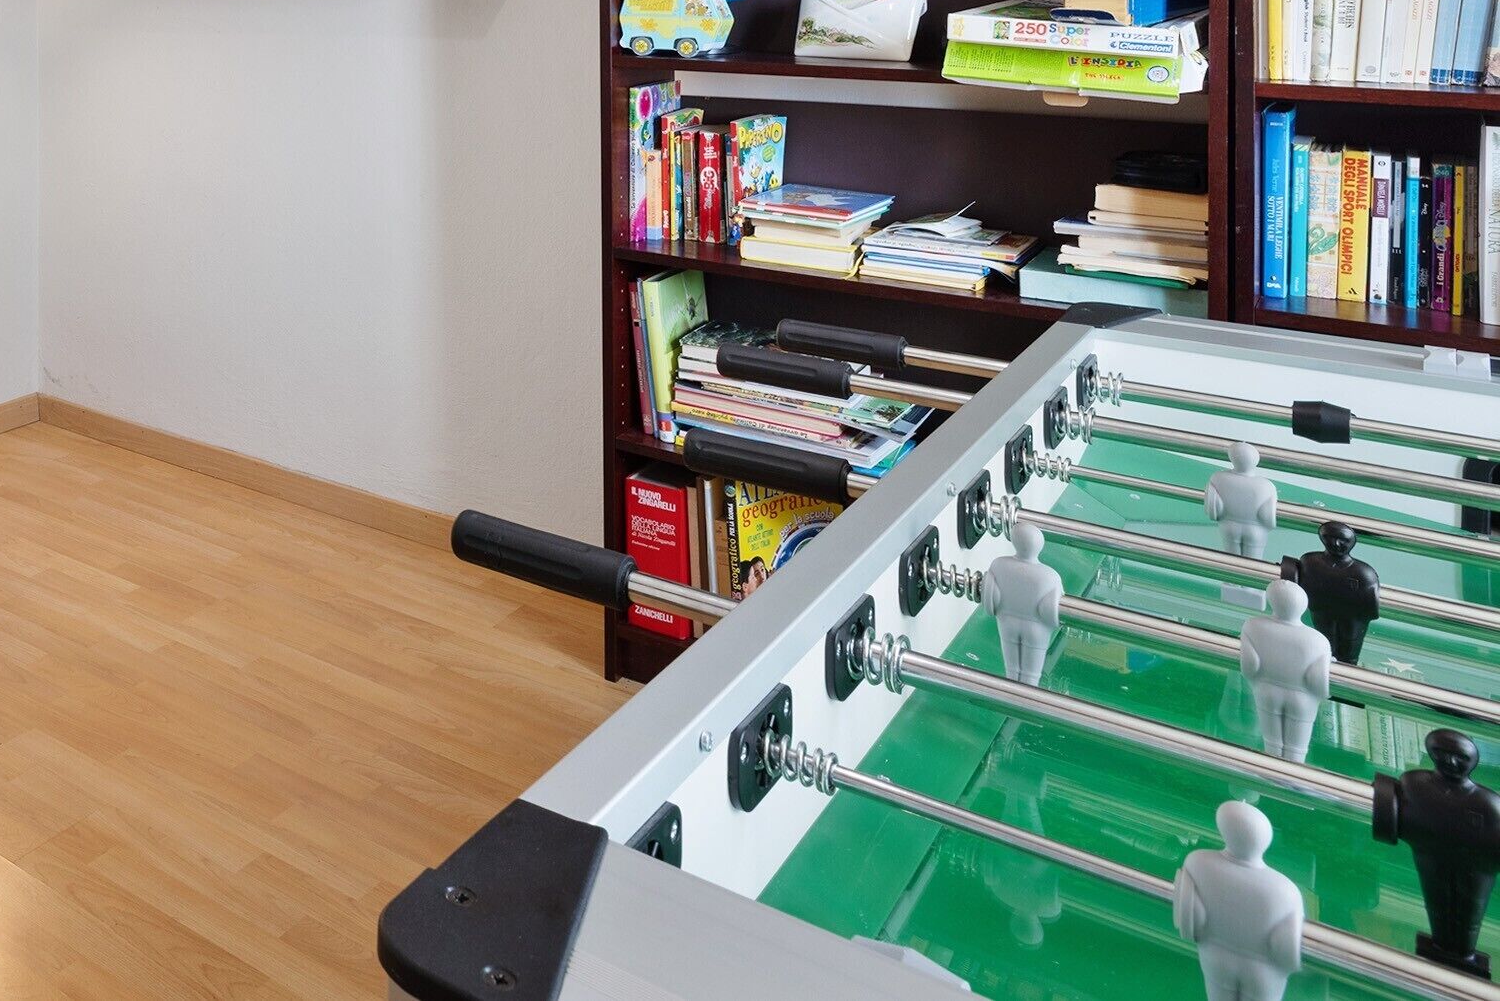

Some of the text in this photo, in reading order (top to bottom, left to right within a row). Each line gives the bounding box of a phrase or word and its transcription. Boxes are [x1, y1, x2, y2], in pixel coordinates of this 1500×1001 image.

[1015, 21, 1090, 37] 250 Super
[1110, 31, 1174, 42] PUZZLE
[1120, 42, 1172, 52] Clementoni
[1356, 159, 1368, 210] MANUALE
[1341, 158, 1356, 275] DEGLI SPORT OLIMPICI
[1275, 195, 1284, 259] VENTIMILA LEGHE
[1436, 252, 1444, 279] Grandi
[631, 486, 661, 499] IL NUOVO
[638, 497, 676, 512] ZINGARELLI
[727, 503, 735, 521] SCUOLA
[631, 514, 676, 531] VOCABOLARIO
[631, 520, 651, 529] DELLA
[780, 522, 793, 539] per
[793, 513, 803, 523] la
[804, 506, 835, 519] scuola
[729, 539, 741, 590] geografico
[634, 606, 674, 624] ZANICHELLI
